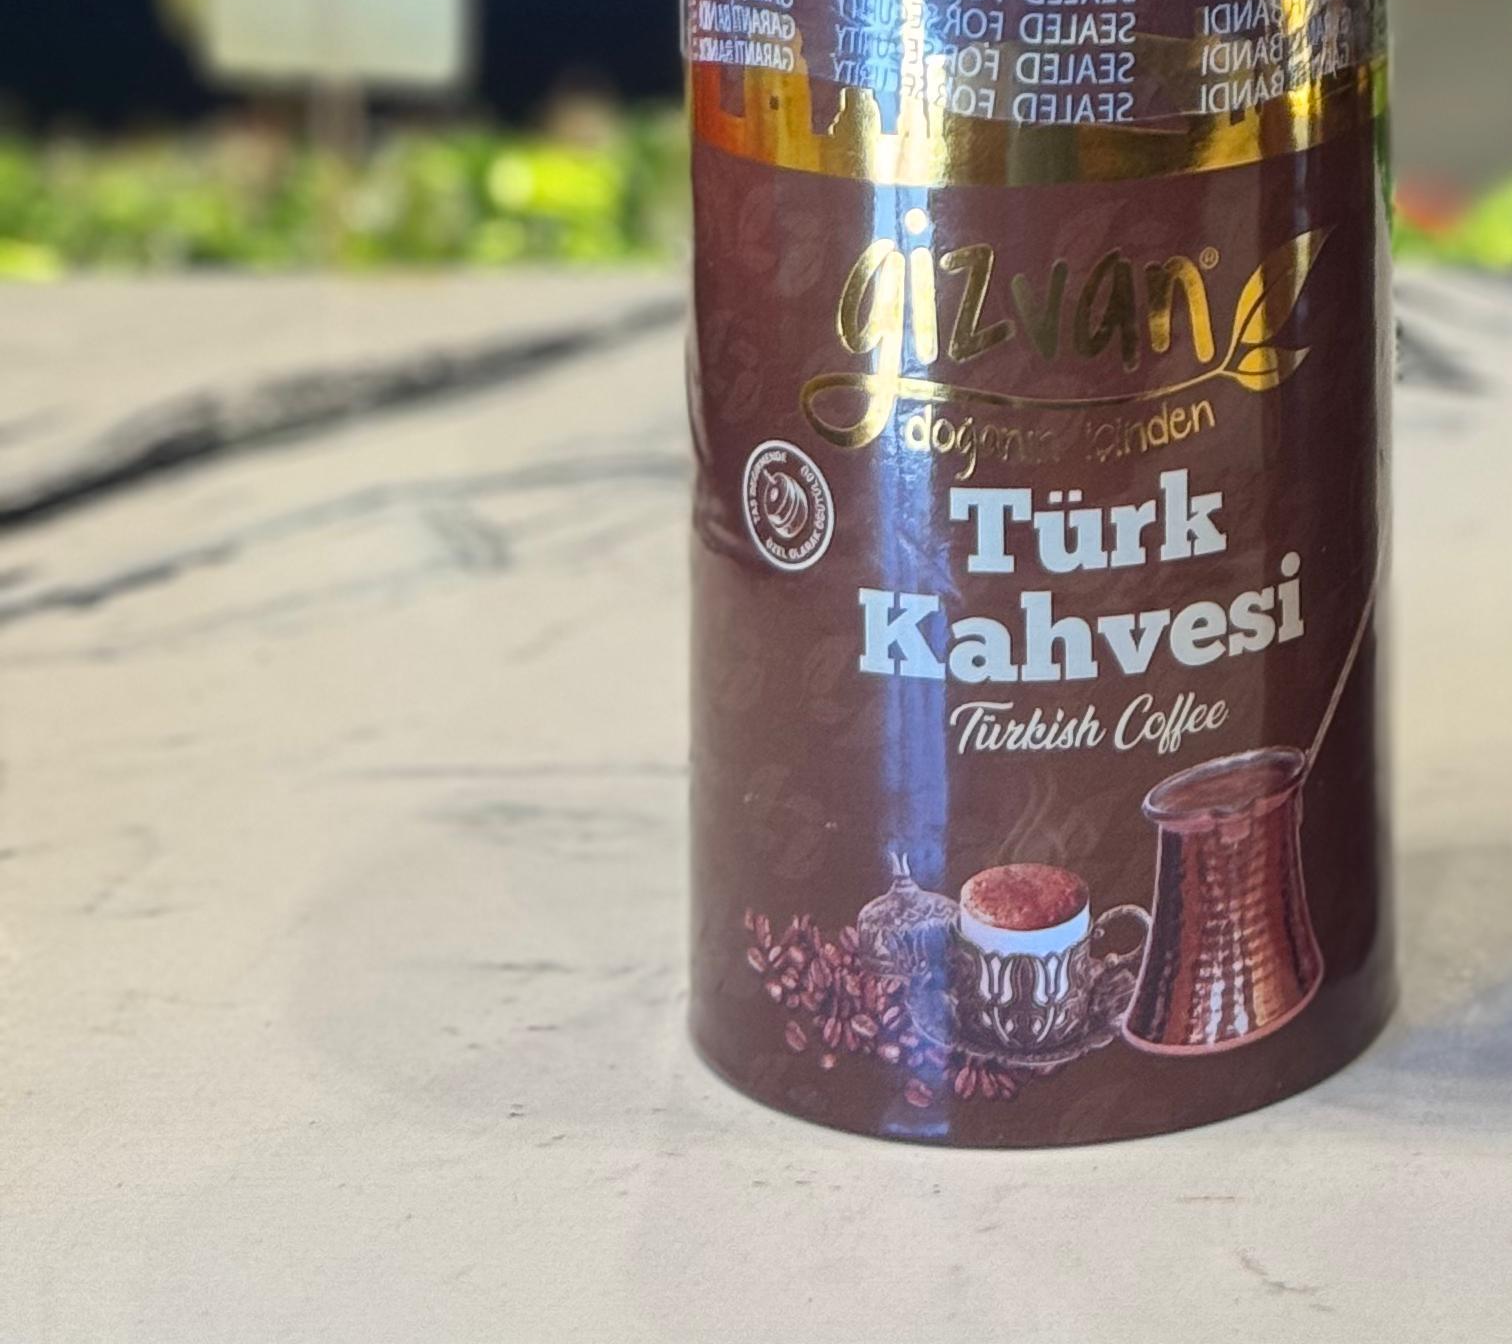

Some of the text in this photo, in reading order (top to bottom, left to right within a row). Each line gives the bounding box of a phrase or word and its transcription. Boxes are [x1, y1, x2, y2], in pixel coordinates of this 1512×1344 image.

[802, 208, 1217, 449] gizvan
[950, 469, 1227, 573] Türk
[858, 551, 1305, 683] Kahvesi
[1114, 693, 1230, 754] Coffee
